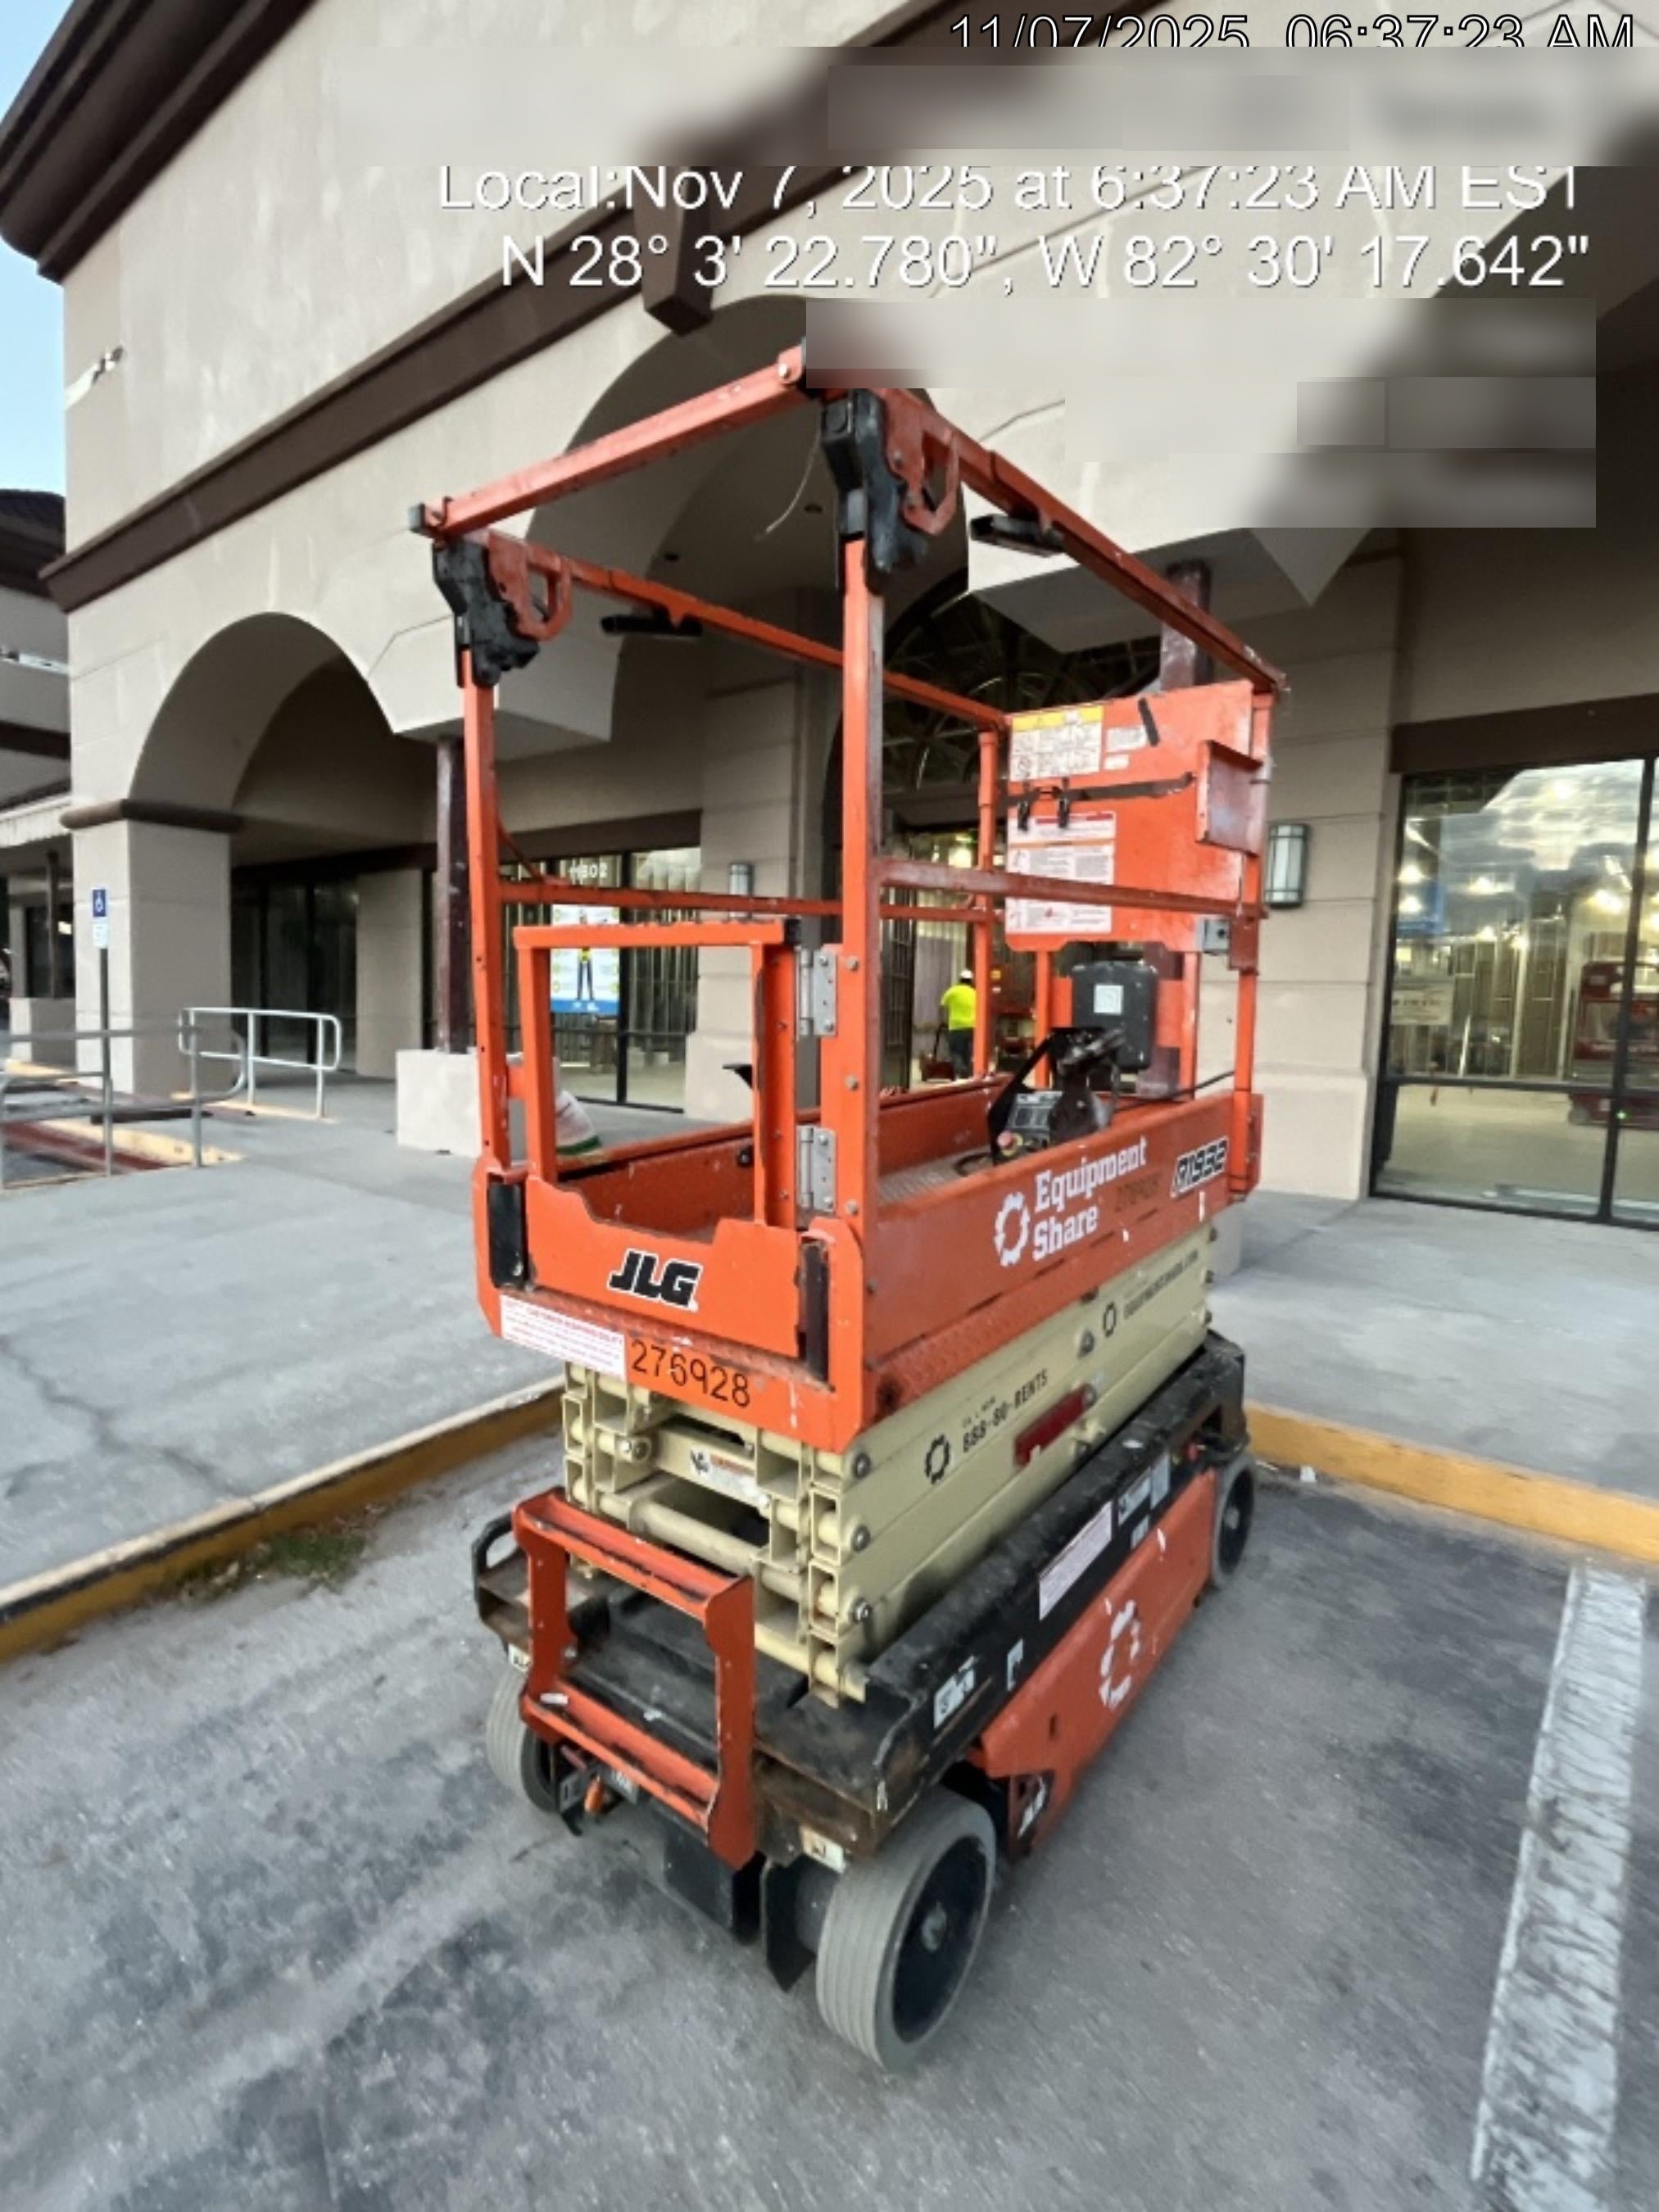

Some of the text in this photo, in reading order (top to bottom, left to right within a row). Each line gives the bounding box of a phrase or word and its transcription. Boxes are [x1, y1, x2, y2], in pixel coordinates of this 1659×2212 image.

[1034, 1135, 1149, 1213] Equipment
[1032, 1205, 1099, 1262] Share
[608, 1249, 703, 1309] JLG
[631, 1339, 750, 1408] 276928
